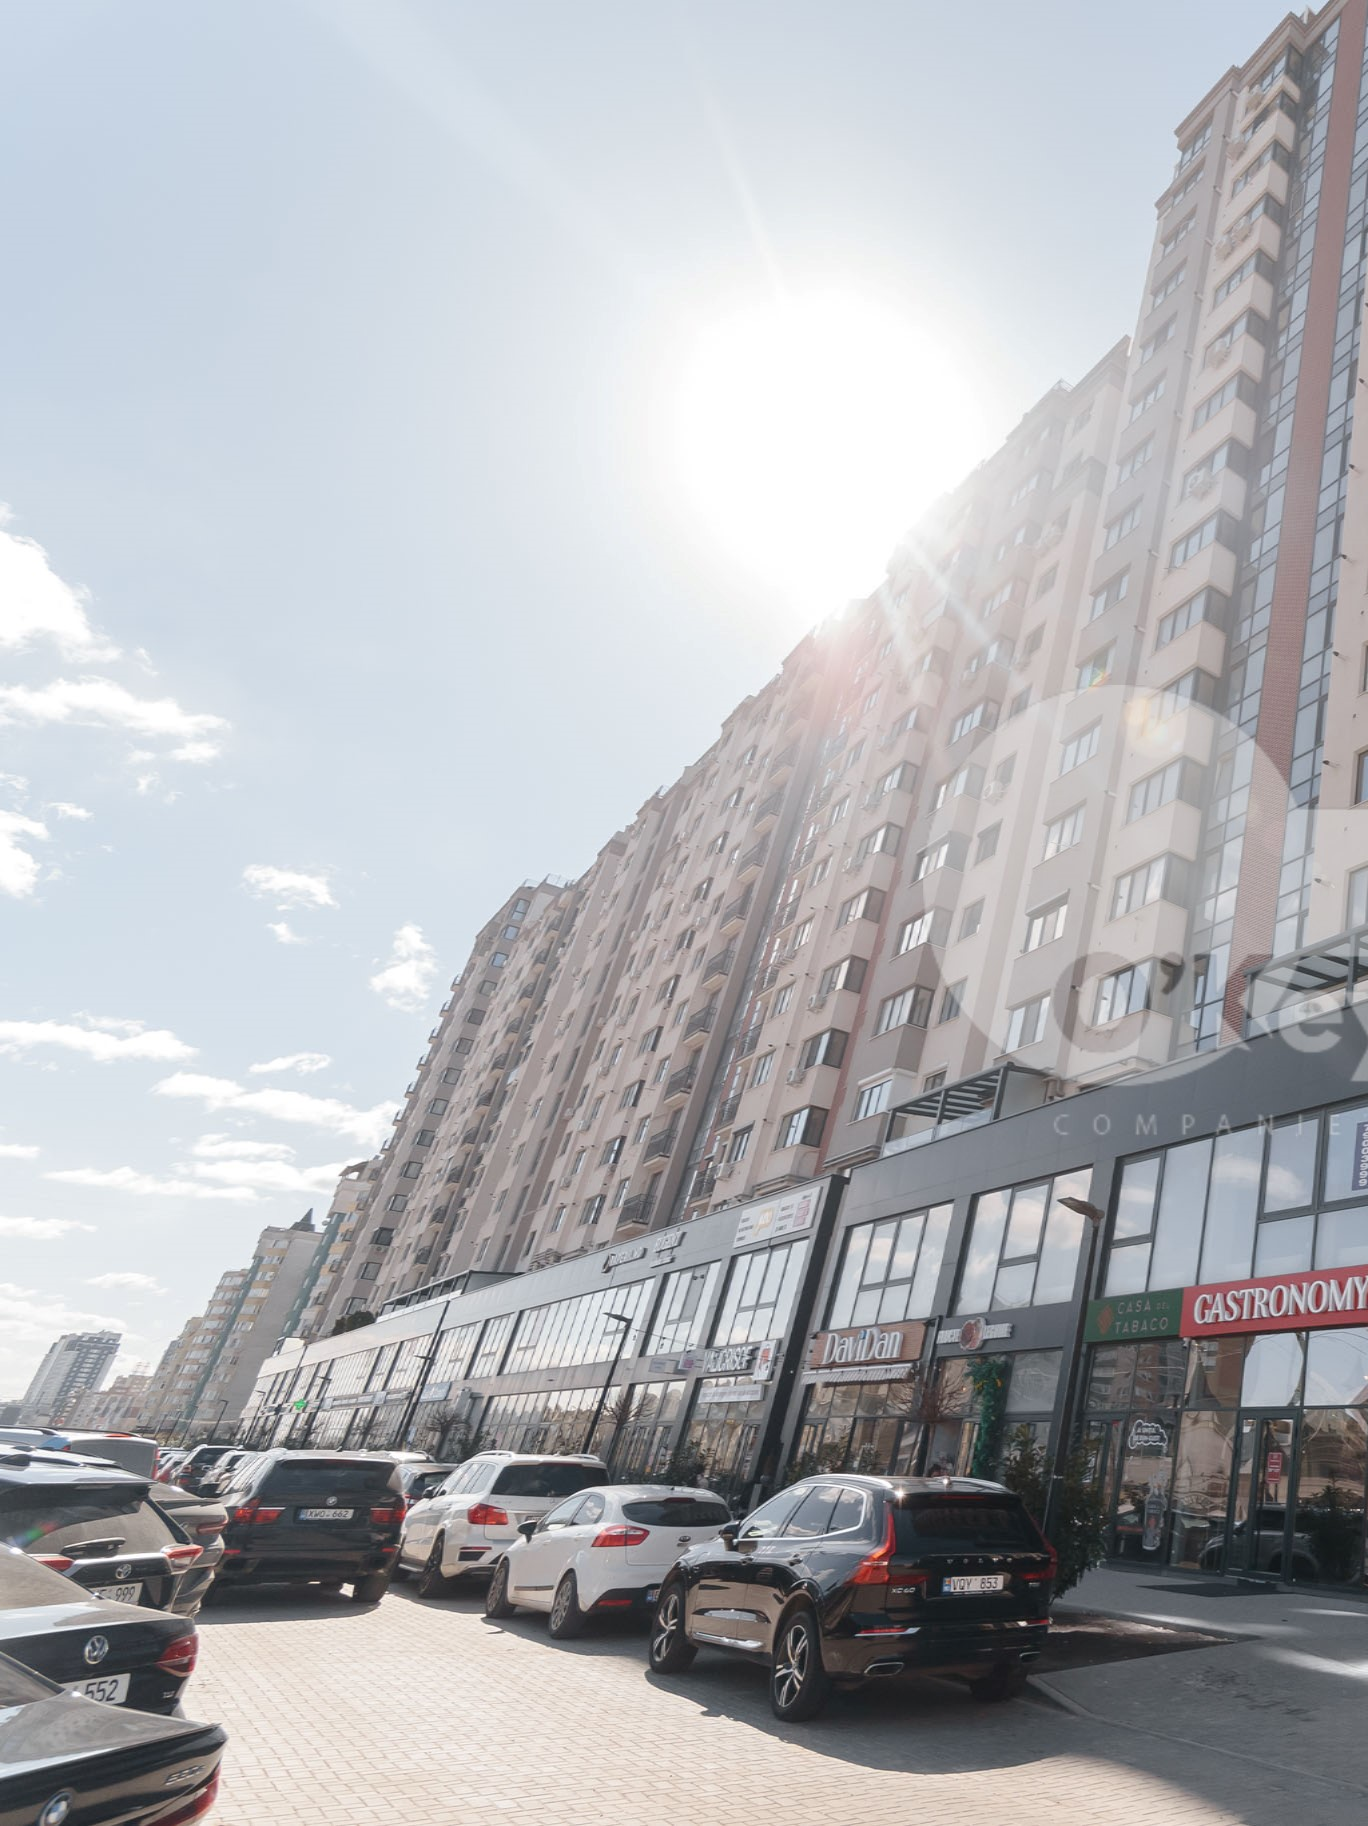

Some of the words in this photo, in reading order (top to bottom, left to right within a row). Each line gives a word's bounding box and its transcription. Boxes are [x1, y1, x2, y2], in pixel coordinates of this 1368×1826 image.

[1117, 1299, 1151, 1315] CASA
[1115, 1317, 1169, 1335] TABACO
[822, 1327, 904, 1365] DaviDan
[332, 1510, 350, 1518] 662
[952, 1578, 972, 1591] VQY
[980, 1577, 999, 1589] 853
[115, 1586, 136, 1601] 999
[85, 1679, 119, 1702] 552
